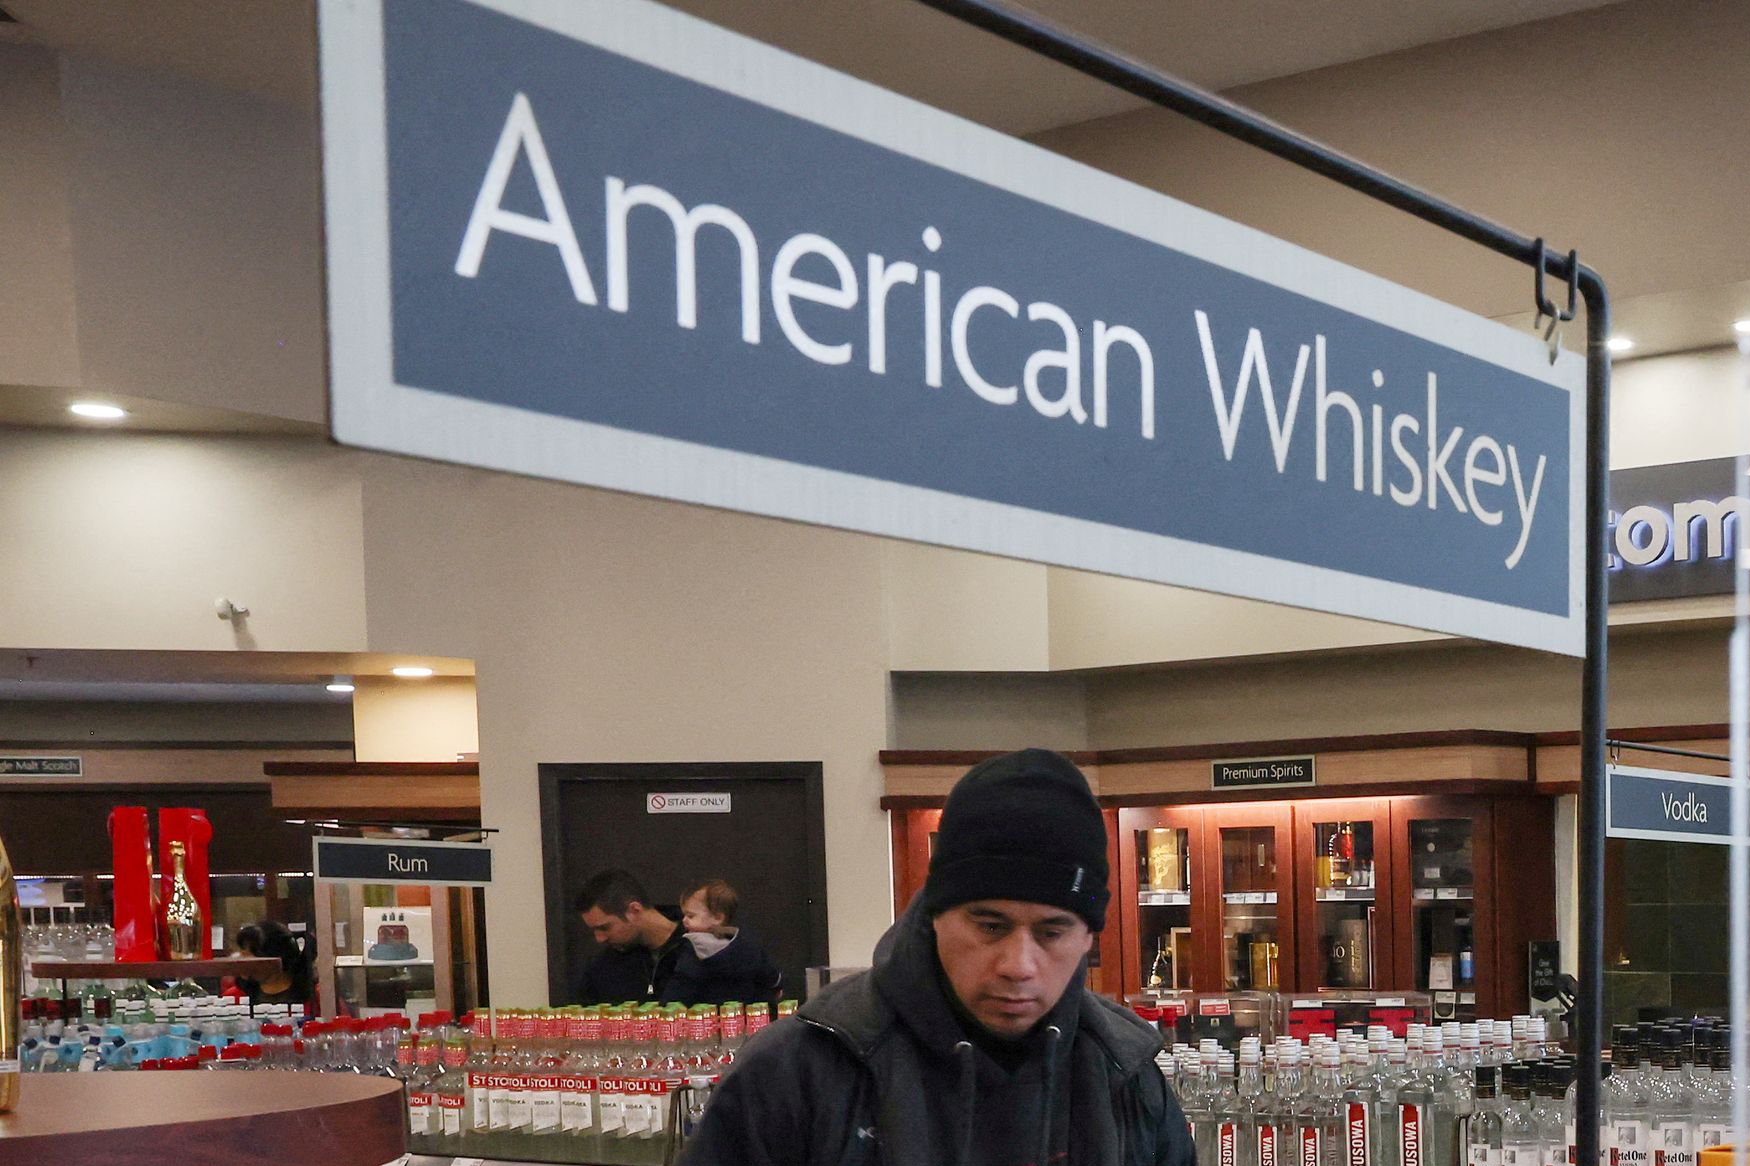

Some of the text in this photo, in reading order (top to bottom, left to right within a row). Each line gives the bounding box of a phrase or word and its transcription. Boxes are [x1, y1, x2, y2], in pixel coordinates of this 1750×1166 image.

[454, 90, 1547, 571] American Whiskey
[15, 760, 39, 770] Malt
[41, 760, 77, 771] Scotch
[1223, 763, 1304, 780] Premium Spirits
[667, 798, 725, 807] STAFF ONLY
[1661, 791, 1708, 823] Vodka
[388, 853, 428, 872] Rum
[1632, 1150, 1647, 1161] One
[1678, 1152, 1692, 1163] One
